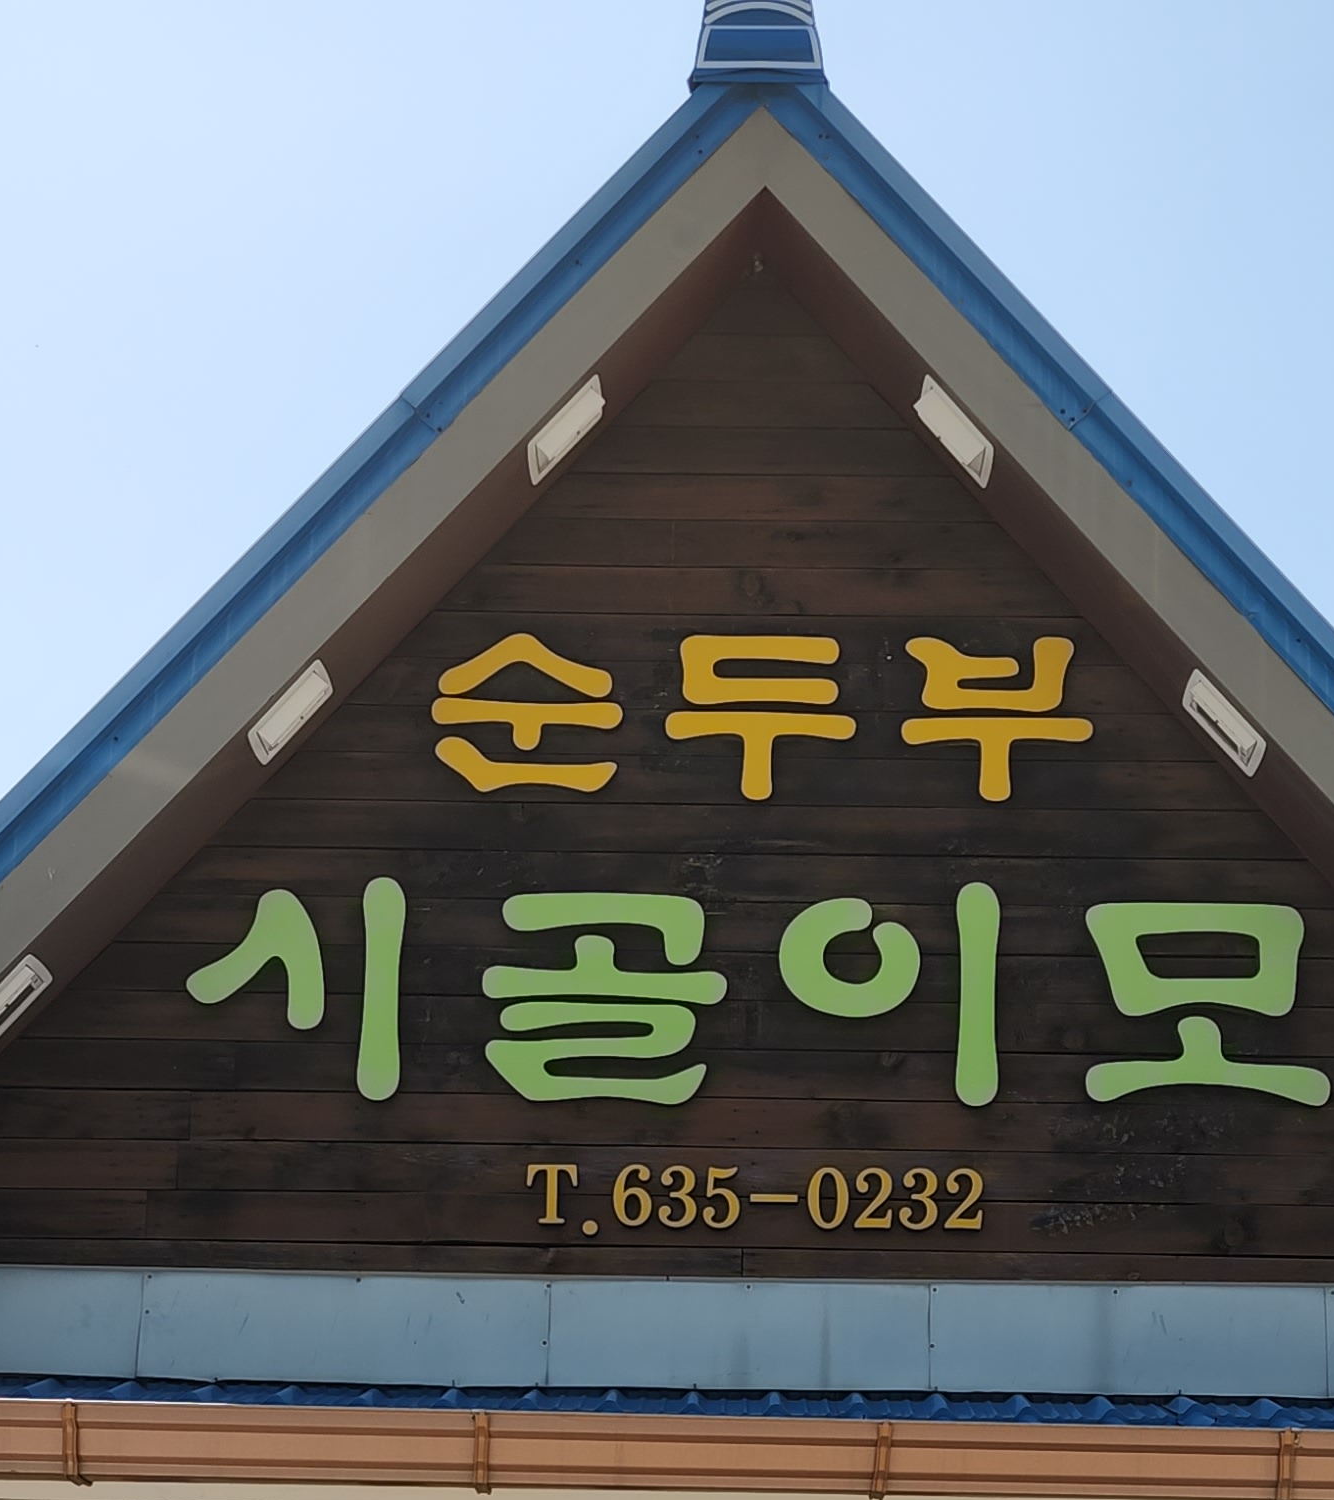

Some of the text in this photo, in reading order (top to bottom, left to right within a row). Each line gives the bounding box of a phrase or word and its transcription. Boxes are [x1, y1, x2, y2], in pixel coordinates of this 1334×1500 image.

[431, 632, 1094, 801] 순두부
[185, 875, 1332, 1107] 시골이모
[525, 1161, 986, 1237] T.635-0232
